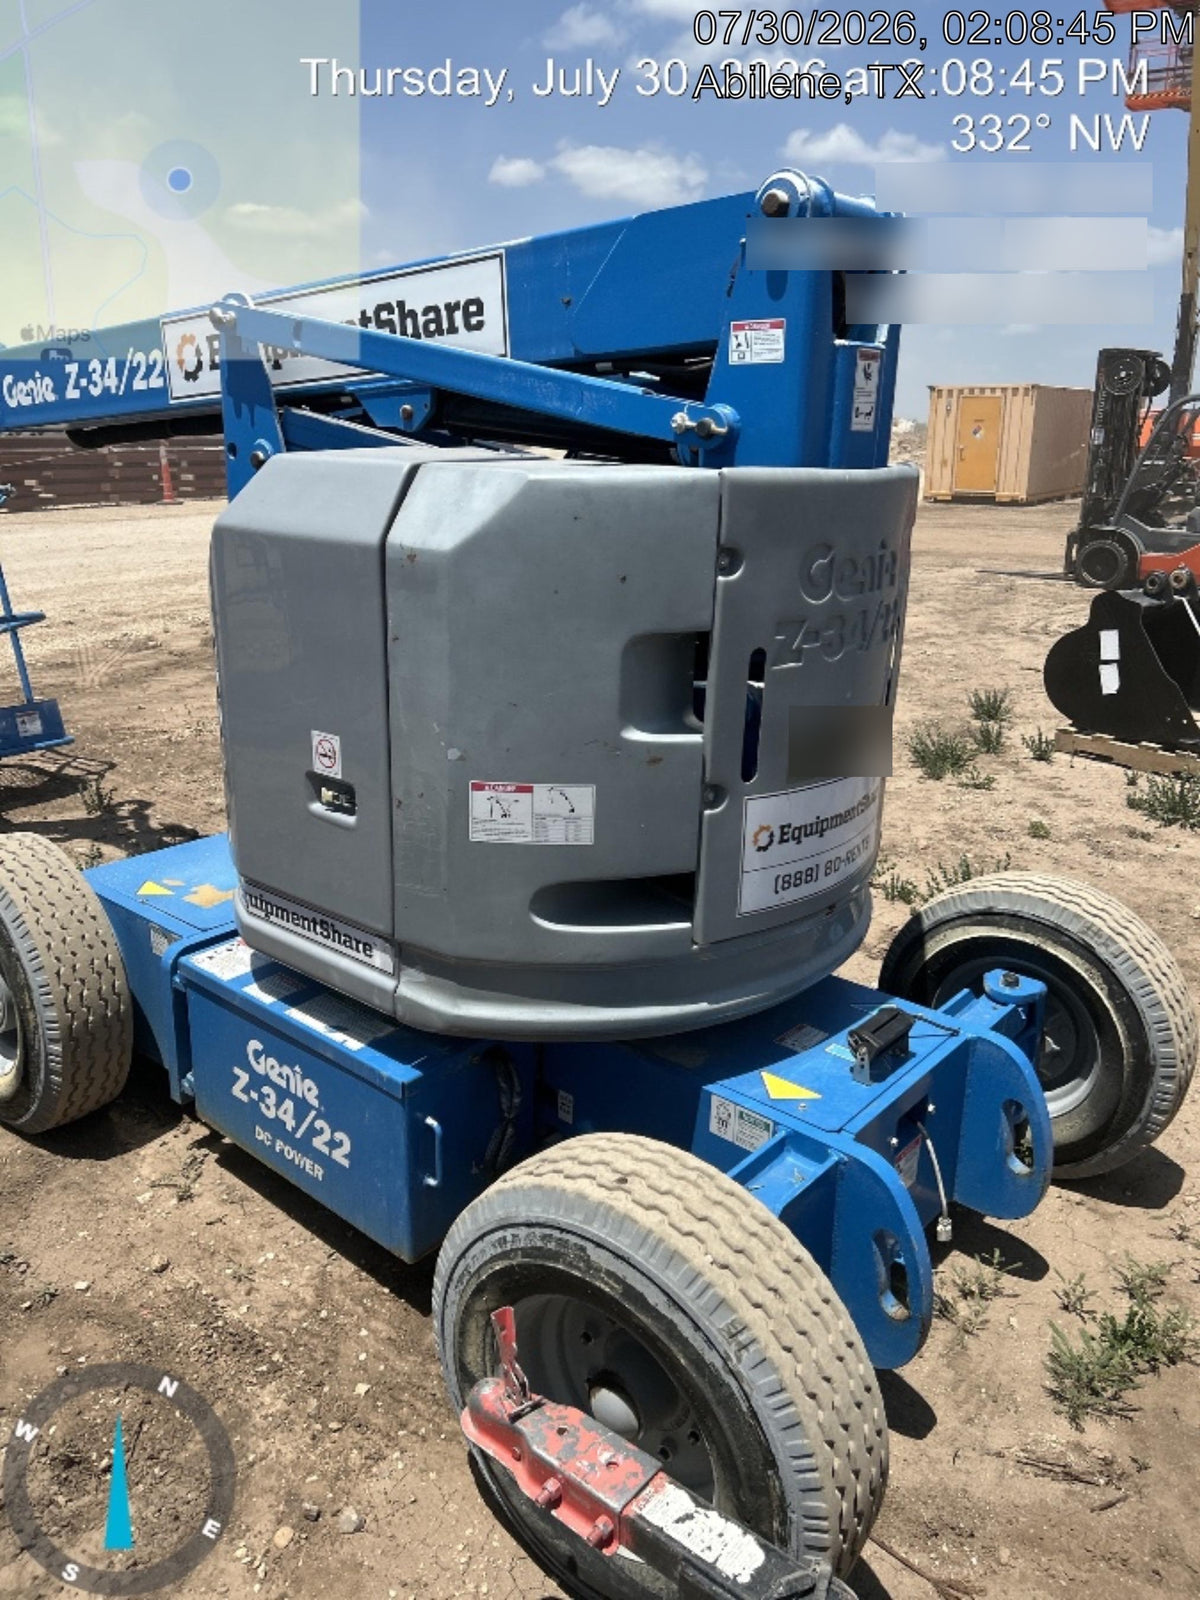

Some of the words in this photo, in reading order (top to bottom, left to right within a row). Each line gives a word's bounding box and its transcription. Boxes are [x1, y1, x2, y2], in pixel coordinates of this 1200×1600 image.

[2, 370, 58, 408] Genie
[64, 347, 164, 399] Z-34/22
[774, 863, 820, 895] (888)
[246, 1039, 320, 1109] Genie
[231, 1066, 351, 1169] Z-34/22
[255, 1124, 273, 1147] DC
[275, 1138, 325, 1182] POWER
